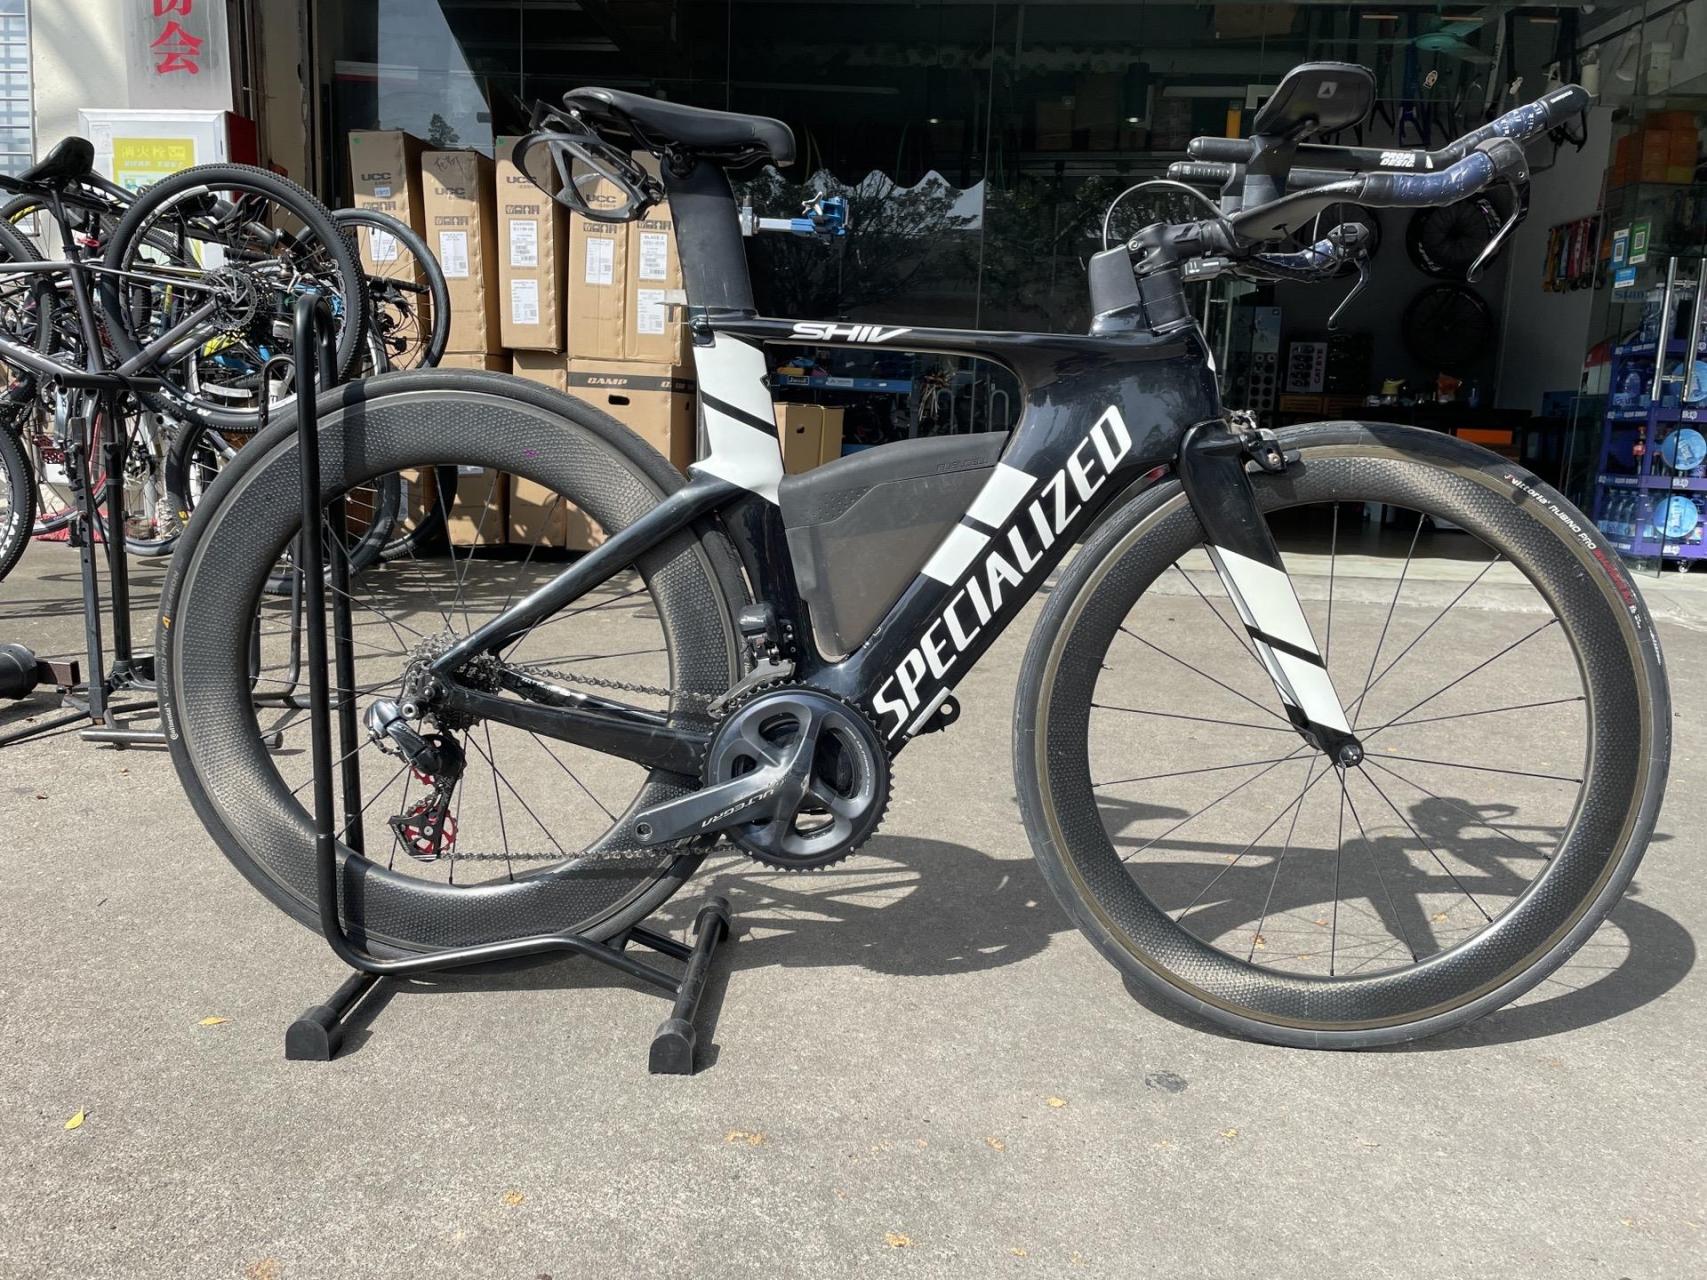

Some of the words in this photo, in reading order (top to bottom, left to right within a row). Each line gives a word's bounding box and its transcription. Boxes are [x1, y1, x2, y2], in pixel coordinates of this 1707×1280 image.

[788, 322, 913, 343] SHIV
[872, 404, 1133, 740] SPECIALIZED
[701, 789, 775, 828] ULTEGRA
